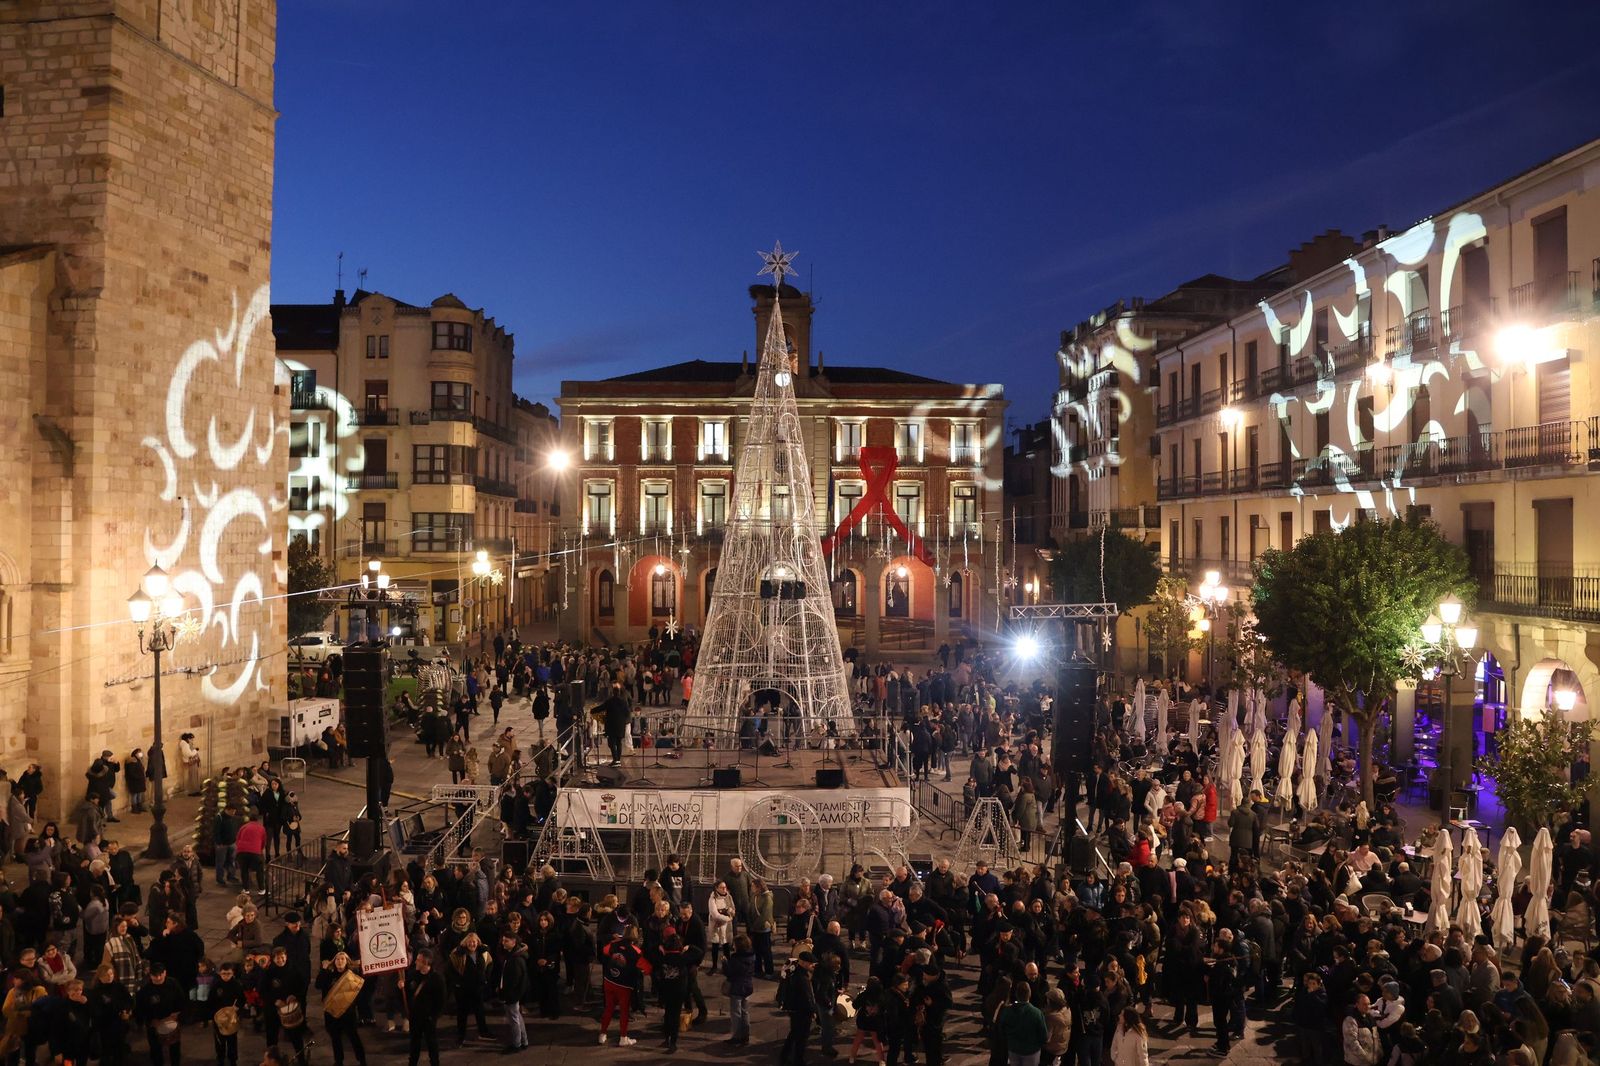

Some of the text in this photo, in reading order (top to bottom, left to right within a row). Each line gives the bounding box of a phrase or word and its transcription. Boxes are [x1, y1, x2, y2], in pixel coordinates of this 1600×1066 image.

[619, 803, 700, 812] AYUNTAMIENTO
[789, 802, 870, 812] AYUNTAMIENTO
[619, 813, 701, 825] DE ZAMORA
[789, 812, 871, 825] DE ZAMORA
[364, 957, 406, 971] BEMBIBRE
